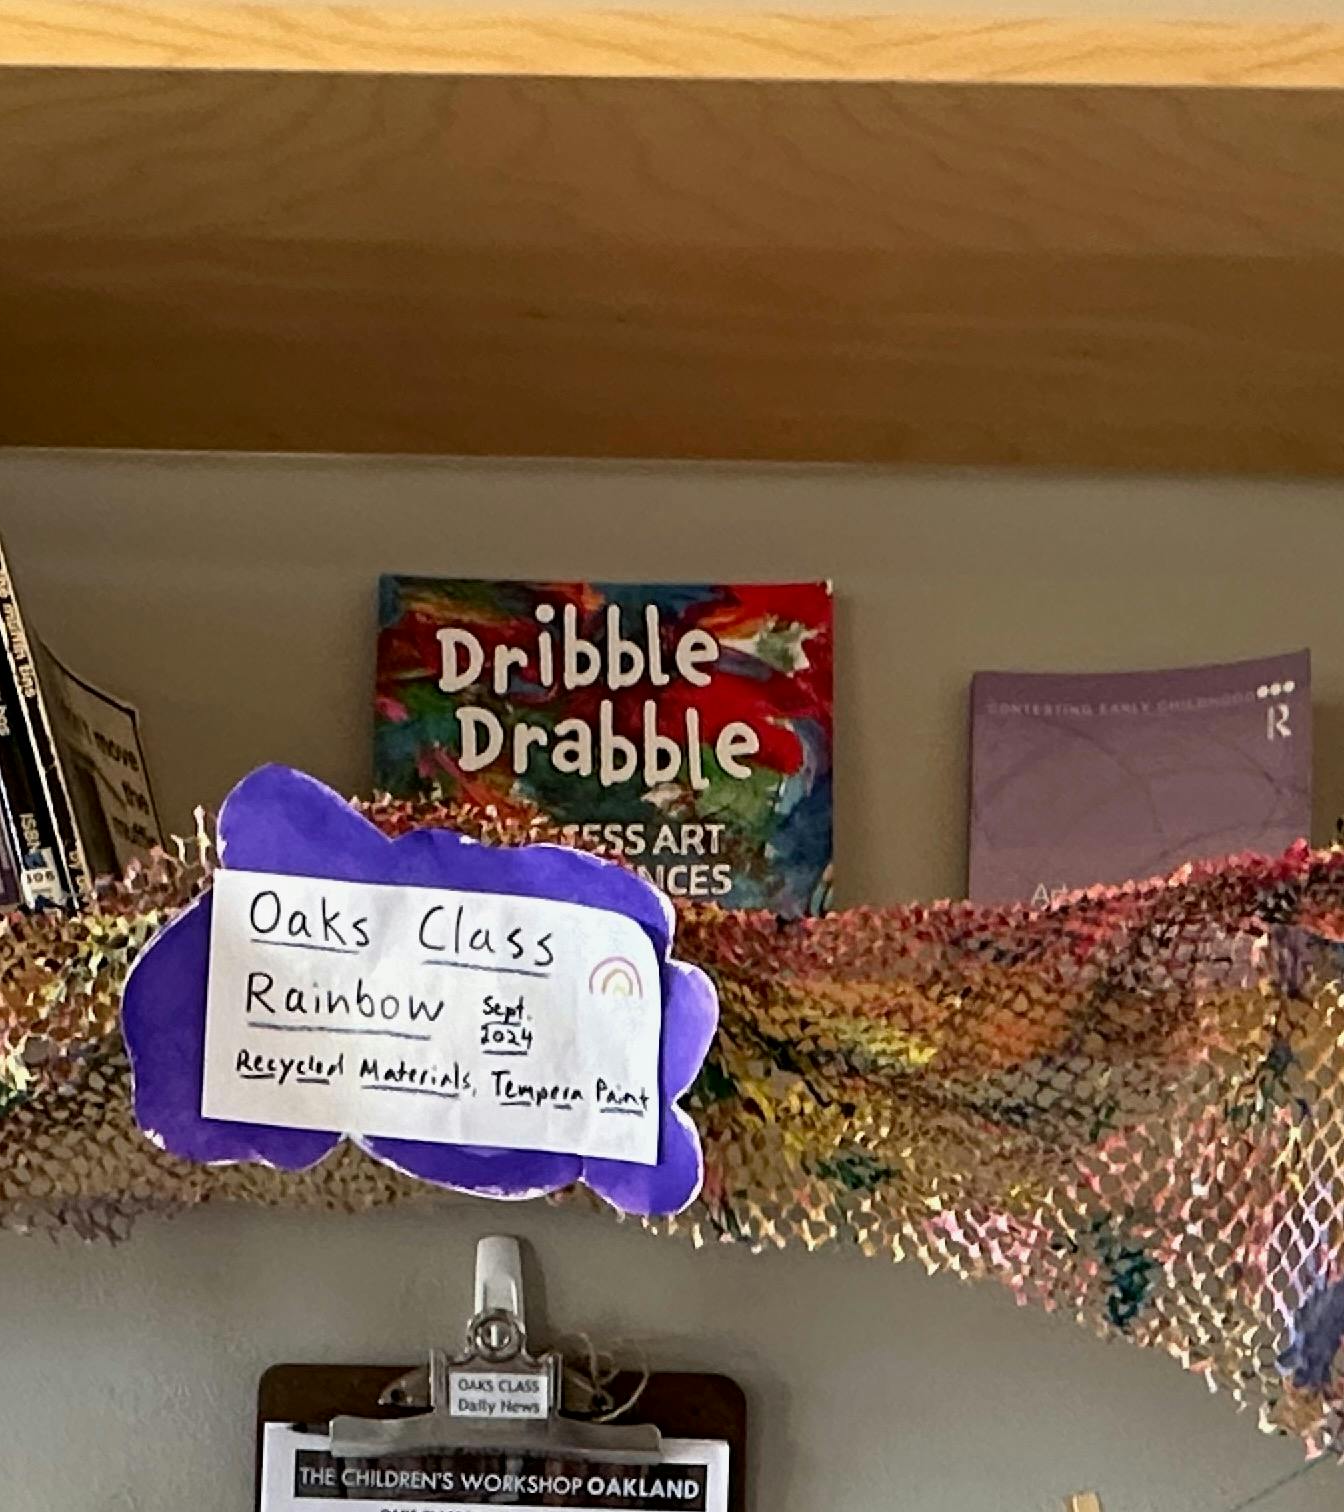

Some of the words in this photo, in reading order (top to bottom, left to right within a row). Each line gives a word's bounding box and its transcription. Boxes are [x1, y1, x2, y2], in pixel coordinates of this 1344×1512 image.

[435, 602, 720, 694] Dribble
[17, 661, 37, 698] tins
[987, 701, 1094, 717] CONTESTING
[1098, 699, 1152, 715] EARLY
[1158, 690, 1256, 713] CHILDHOOD
[455, 698, 761, 790] Drabble
[18, 812, 42, 852] ISBN
[652, 823, 726, 856] ART
[248, 889, 371, 949] Oaks
[418, 904, 555, 966] Class
[245, 971, 447, 1023] Rainbow
[481, 995, 534, 1026] Sept.
[479, 1020, 534, 1050] 2024
[235, 1047, 345, 1086] Recycled
[359, 1057, 478, 1098] Materials,
[490, 1069, 585, 1109] Tempera
[595, 1076, 650, 1111] Paint
[457, 1378, 493, 1392] OAKS
[498, 1378, 541, 1393] CLASS
[457, 1397, 496, 1416] Daily
[500, 1399, 541, 1415] News
[298, 1466, 336, 1487] THE
[340, 1467, 455, 1491] CHILDREN'S
[460, 1473, 582, 1496] WORKSHOP
[586, 1476, 701, 1500] OAKLAND
